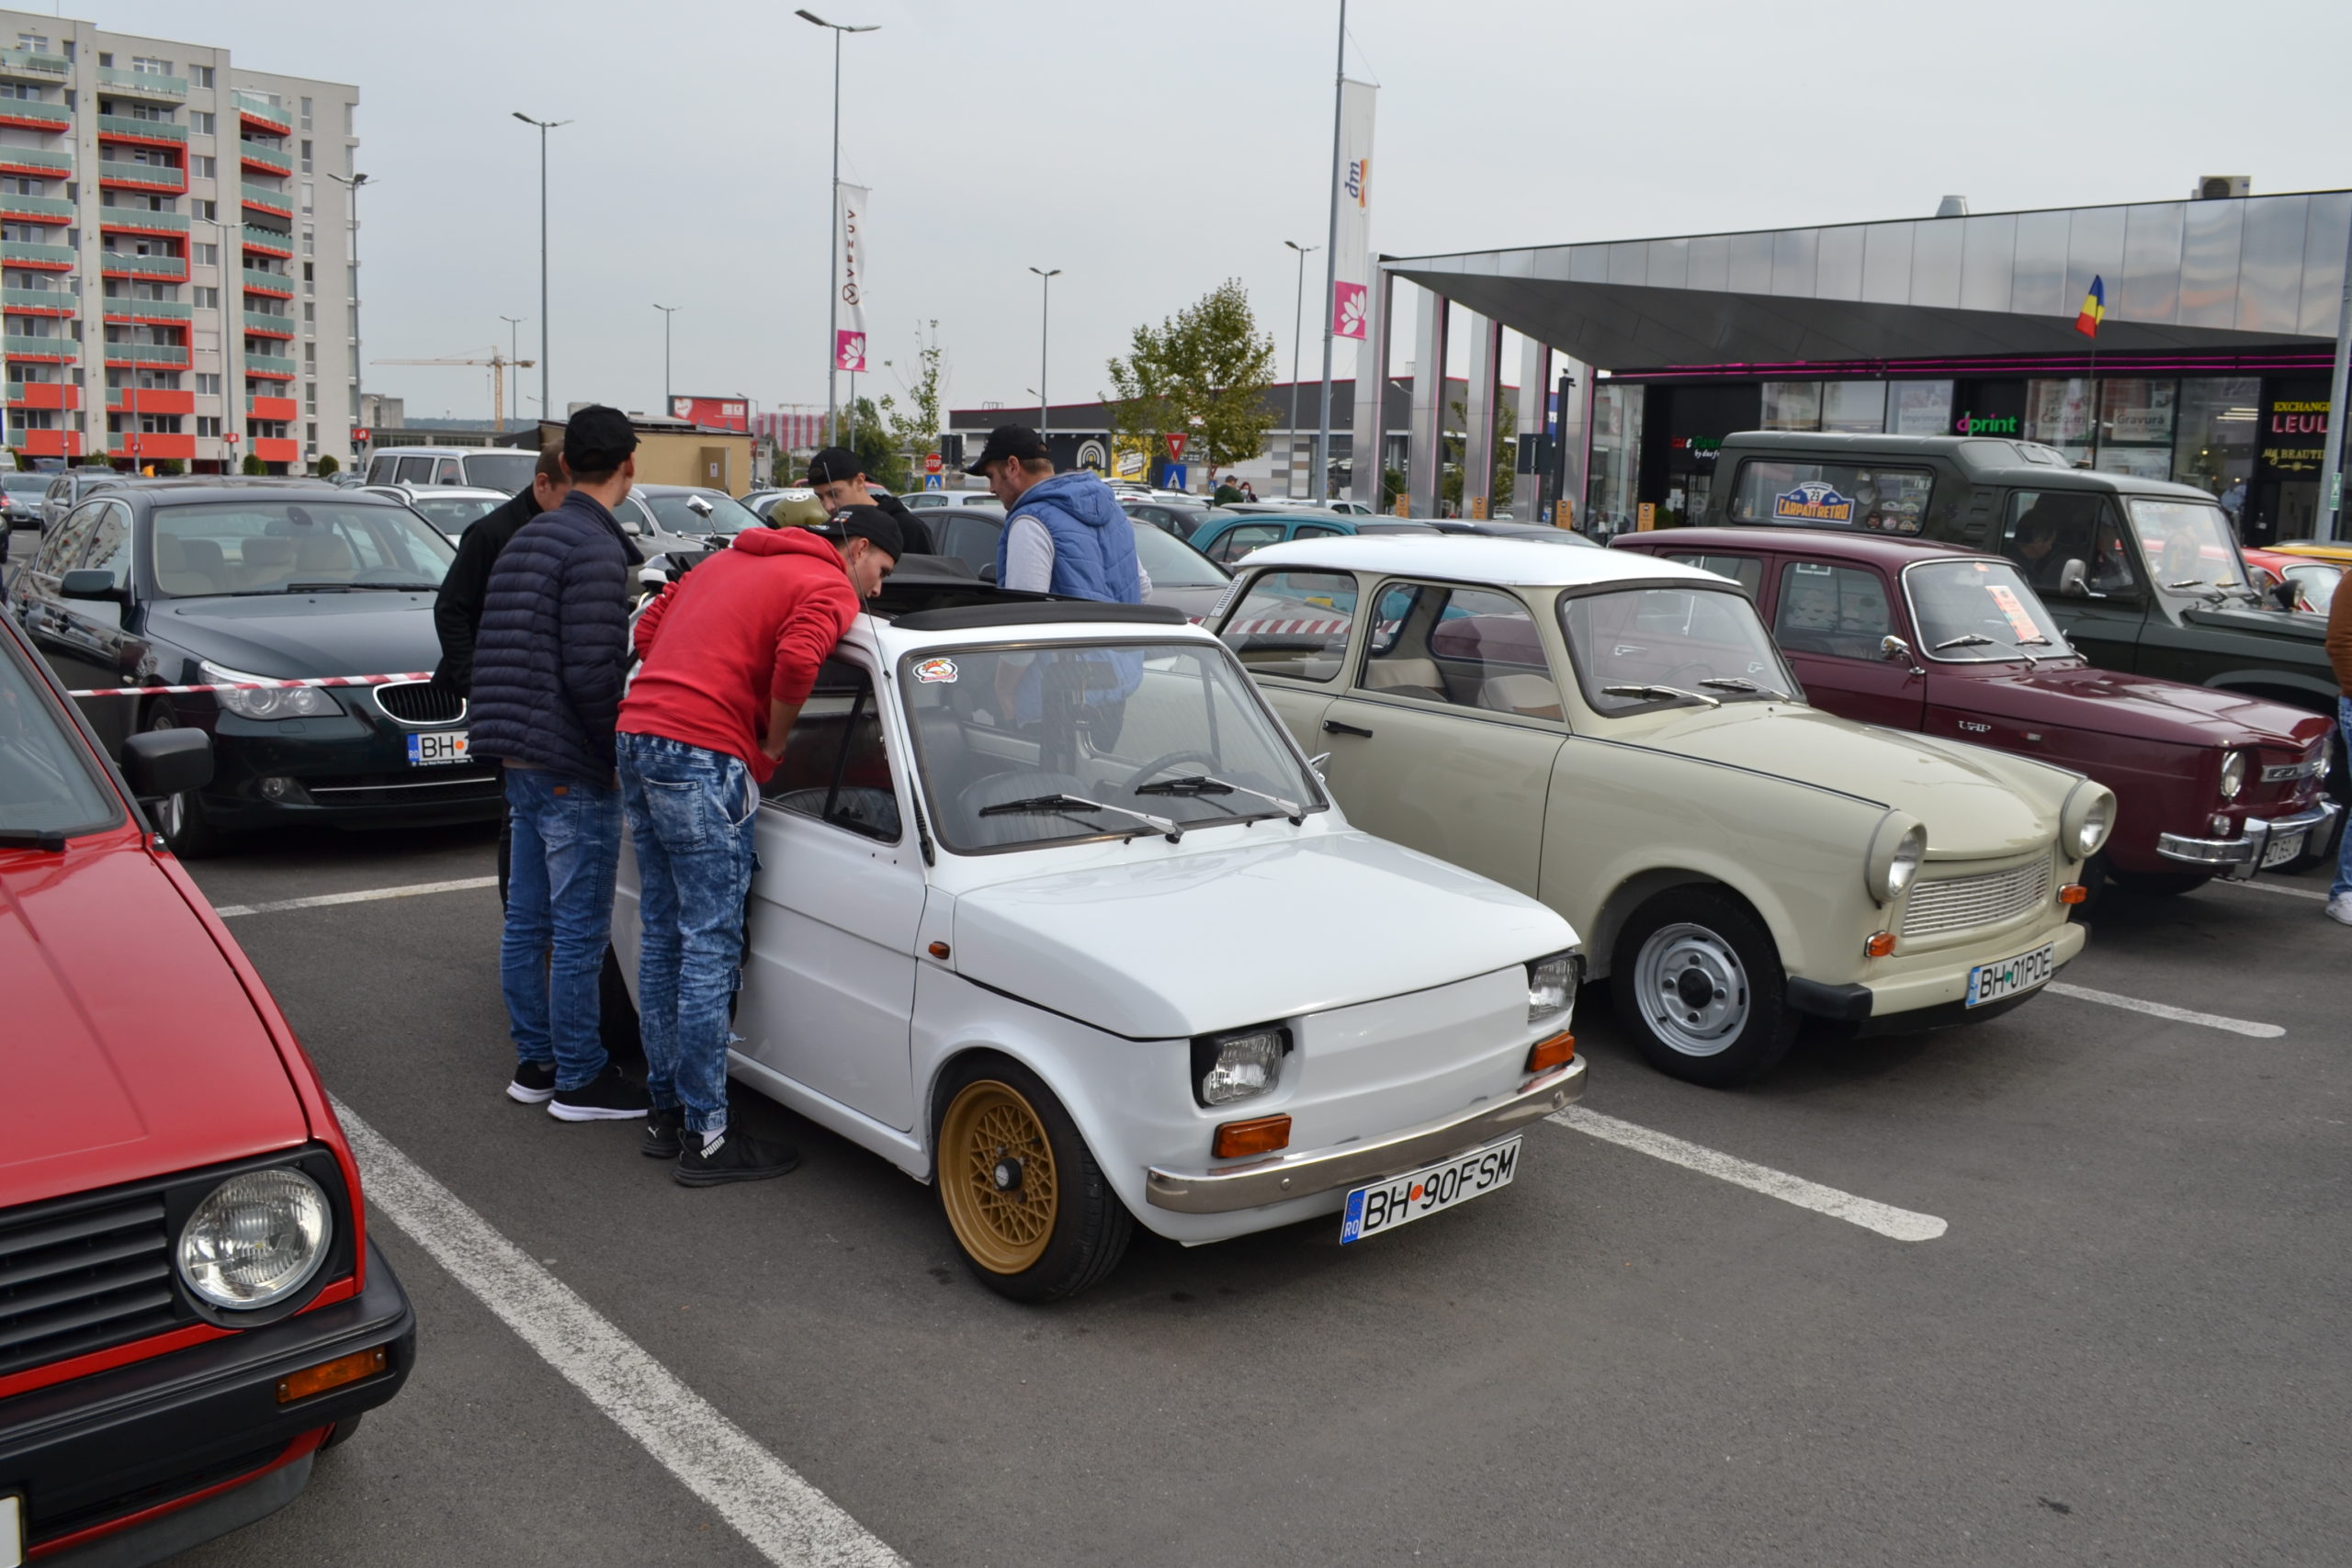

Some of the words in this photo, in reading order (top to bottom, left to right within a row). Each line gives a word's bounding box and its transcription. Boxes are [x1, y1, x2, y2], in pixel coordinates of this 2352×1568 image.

[1344, 162, 1360, 198] dm
[1956, 411, 2018, 436] dprint
[2272, 415, 2330, 433] LEUL
[925, 459, 942, 468] STOP
[1810, 491, 1820, 502] 23
[408, 750, 419, 760] RO
[700, 1135, 725, 1159] PUMA
[1344, 1219, 1360, 1238] RO
